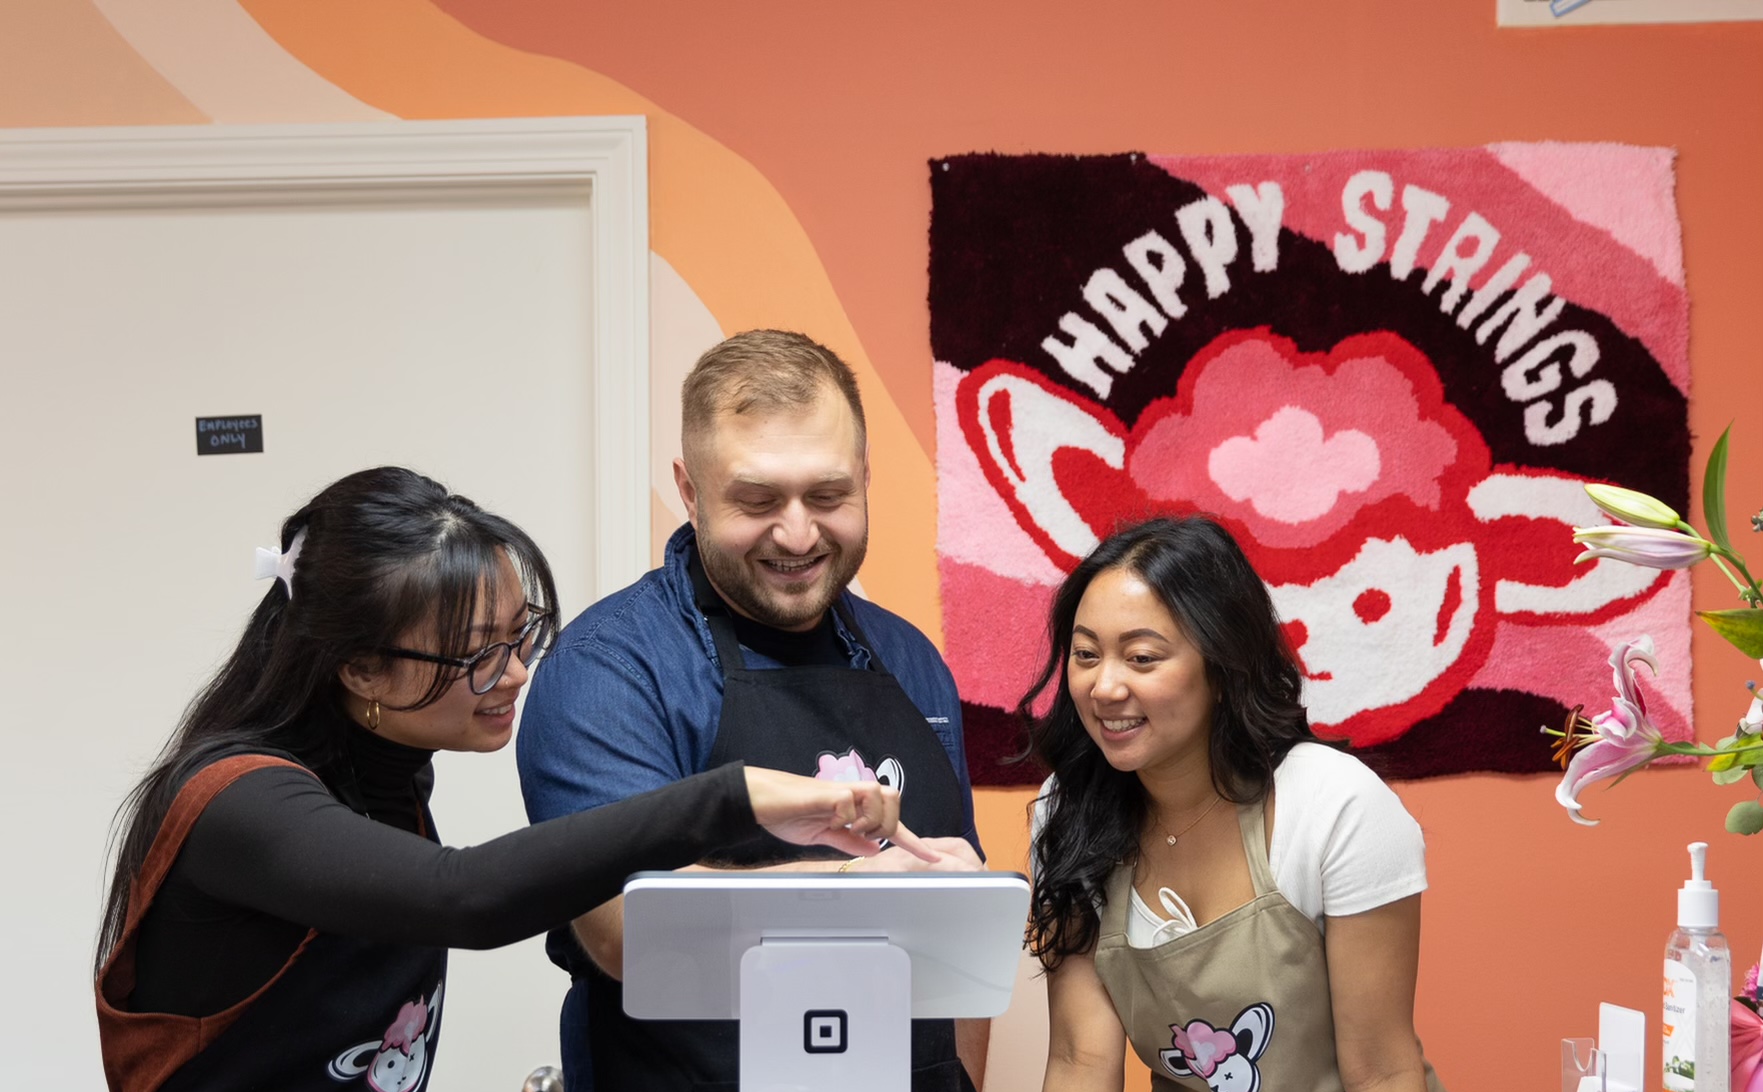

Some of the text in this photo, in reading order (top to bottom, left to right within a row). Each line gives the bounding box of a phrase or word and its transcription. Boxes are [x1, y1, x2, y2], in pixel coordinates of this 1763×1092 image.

[1041, 169, 1618, 446] HAPPY STRINGS
[210, 432, 246, 449] ONLY
